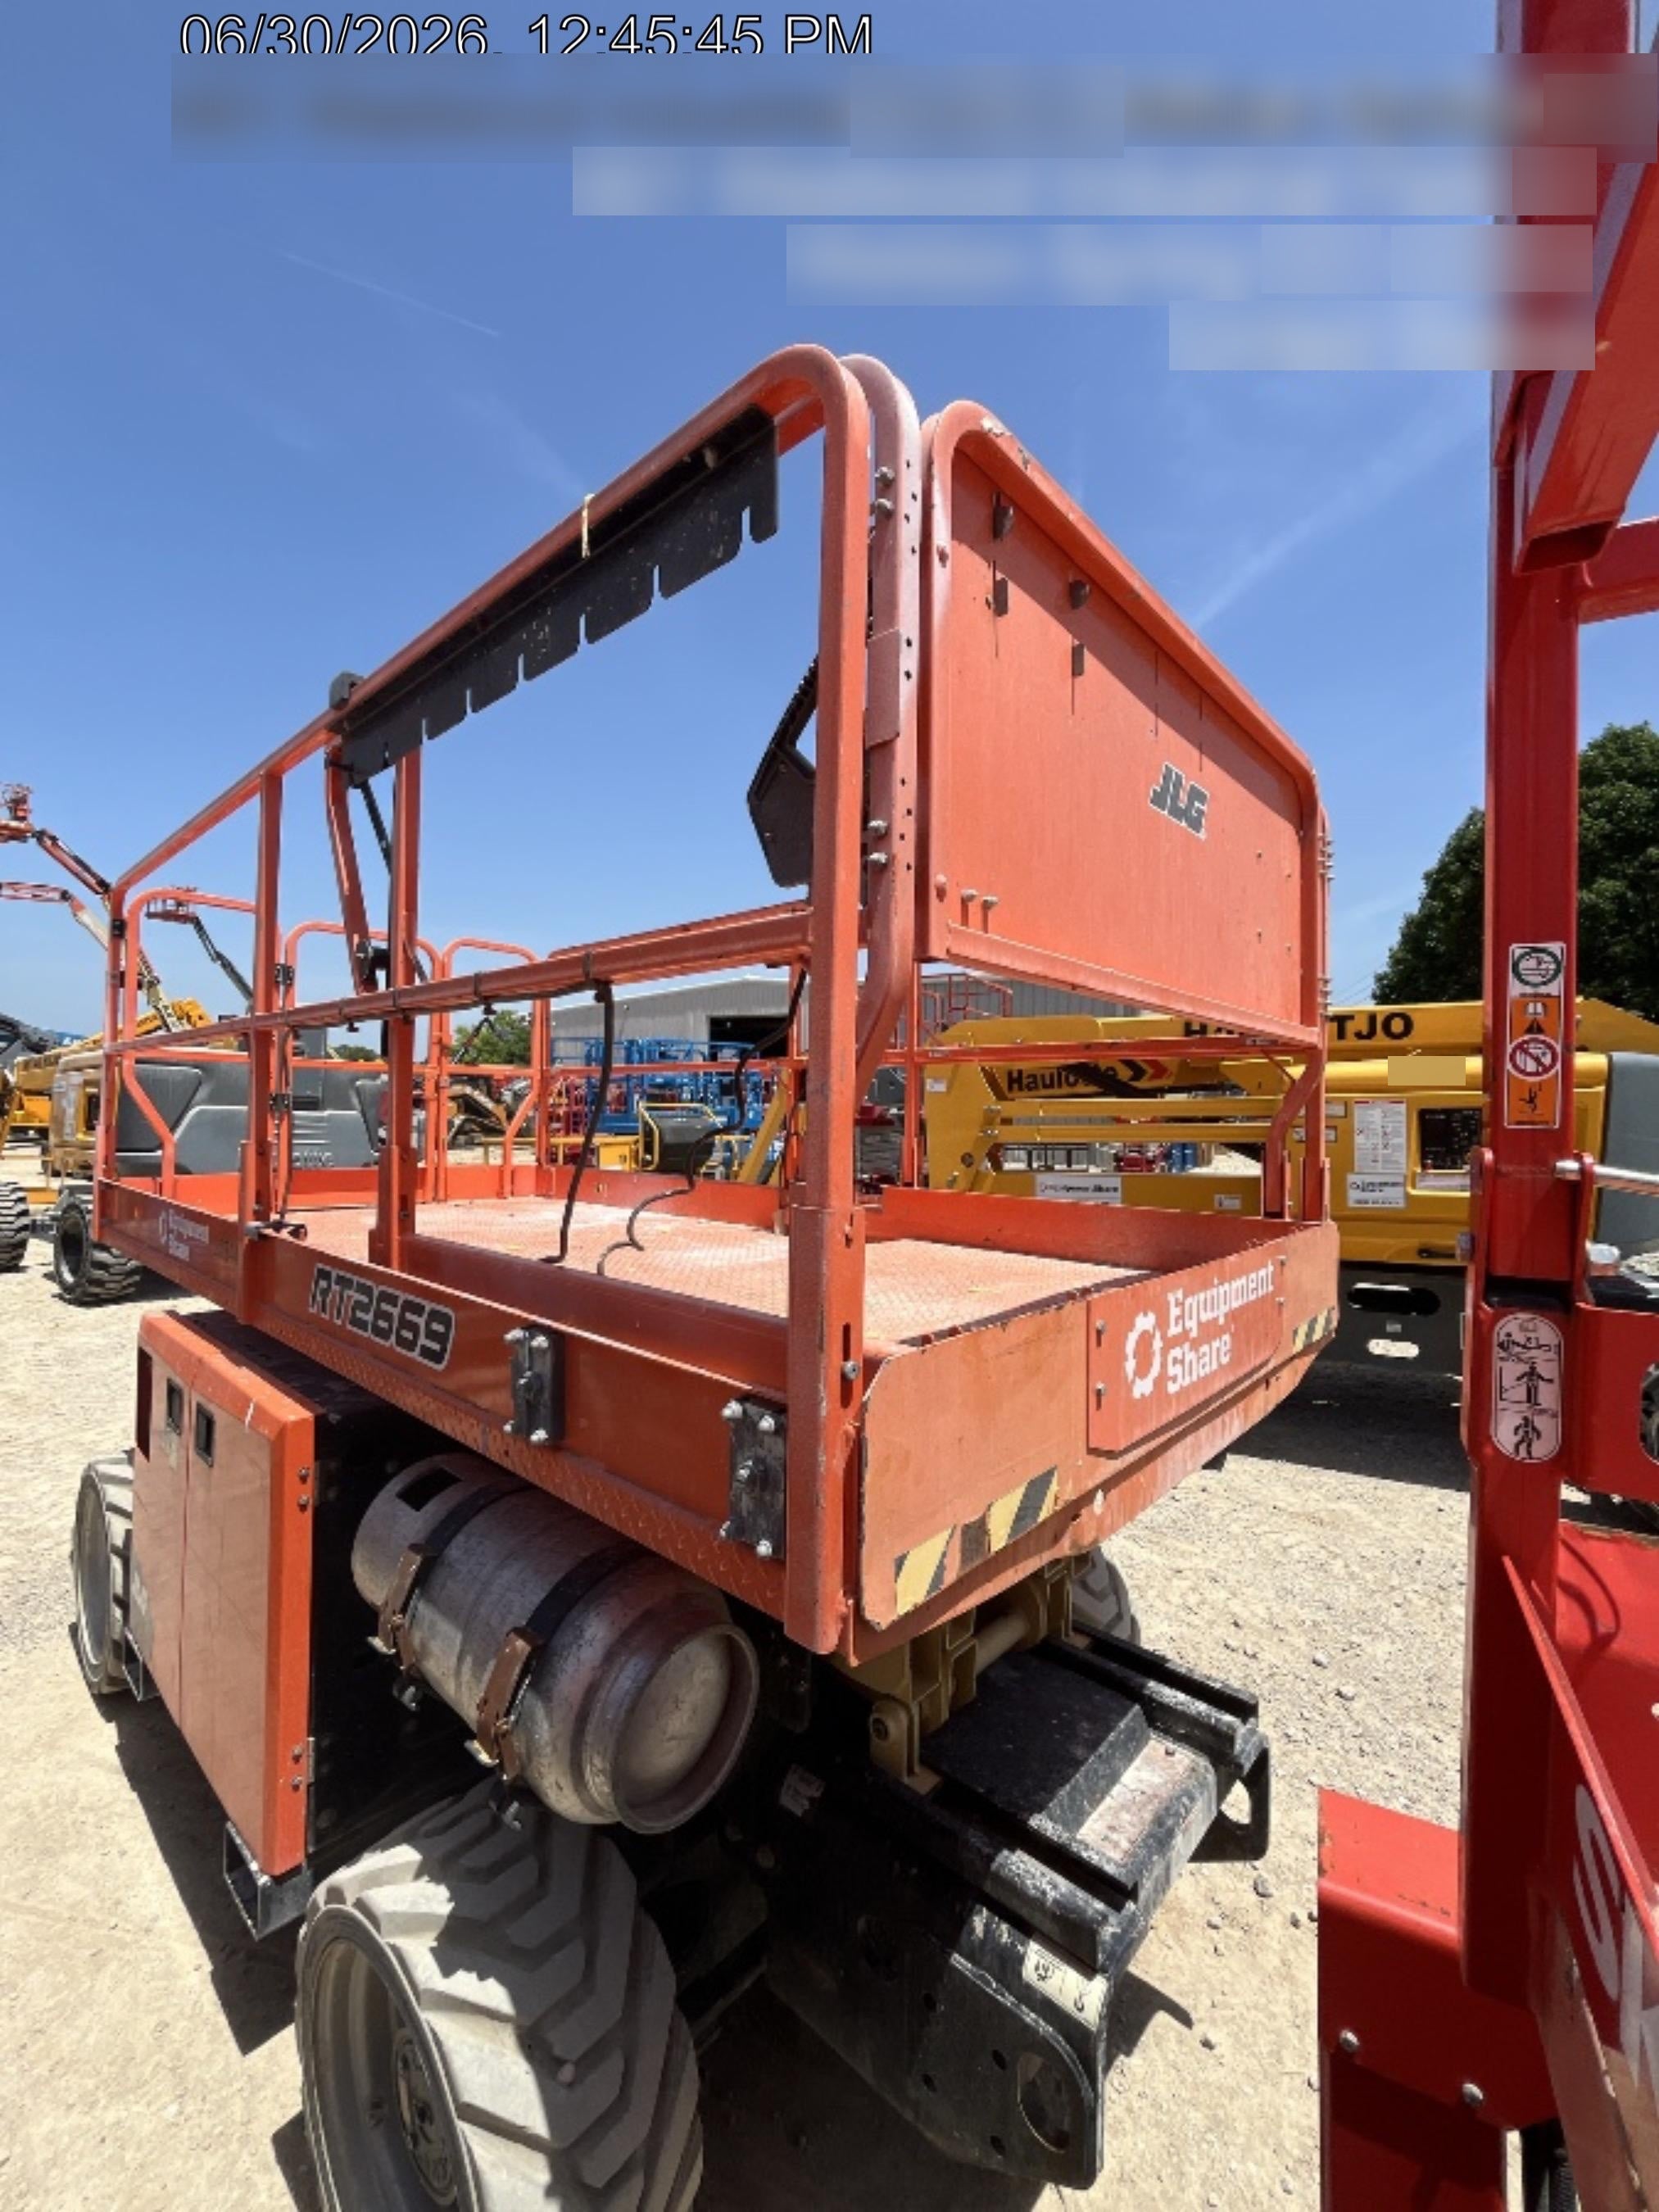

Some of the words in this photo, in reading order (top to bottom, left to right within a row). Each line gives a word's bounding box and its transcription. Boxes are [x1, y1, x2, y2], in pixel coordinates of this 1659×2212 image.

[1149, 761, 1210, 841] JLG
[1007, 1066, 1118, 1092] Hauloe
[309, 1262, 456, 1371] RT2669
[1167, 1260, 1275, 1338] Equipment
[1167, 1329, 1232, 1394] Share
